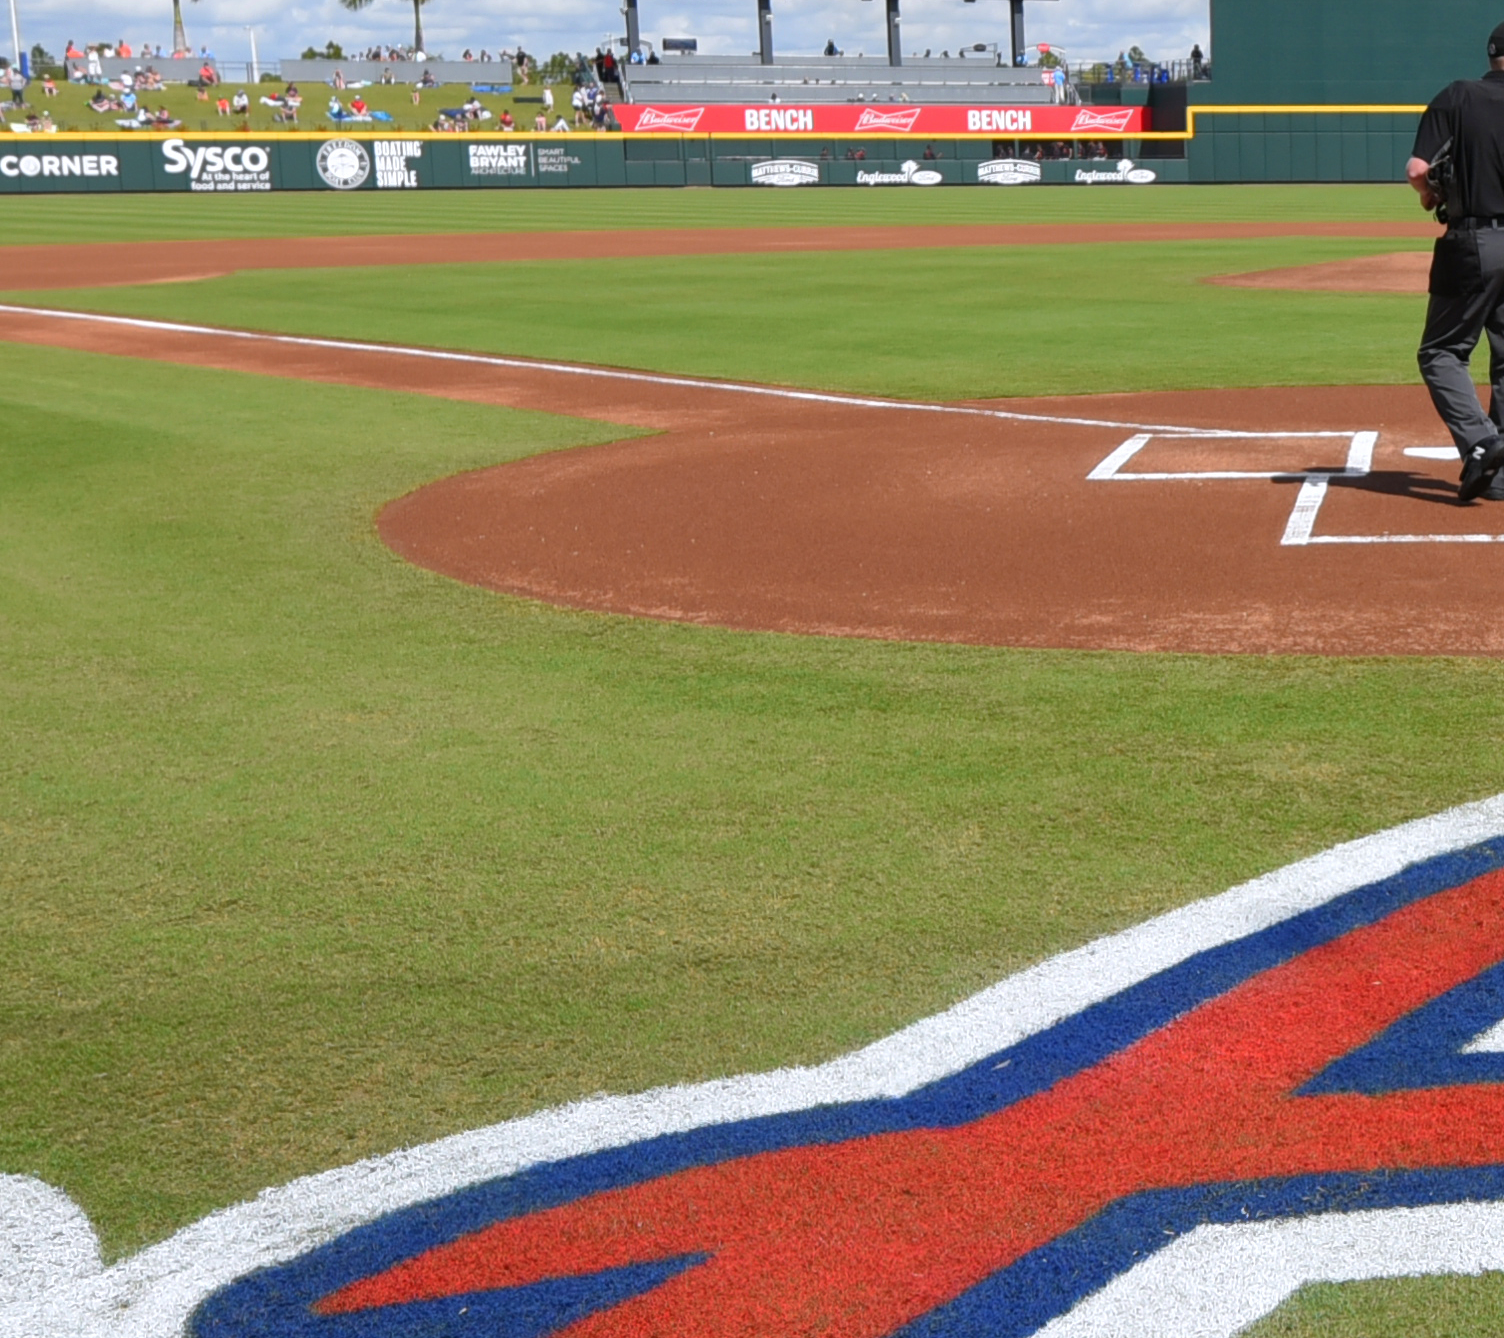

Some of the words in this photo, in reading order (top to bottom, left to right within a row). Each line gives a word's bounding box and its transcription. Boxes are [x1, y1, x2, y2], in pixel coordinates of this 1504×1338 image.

[638, 113, 699, 127] Budweiser
[745, 109, 814, 131] BENCH
[858, 113, 917, 127] Budweiser
[967, 110, 1032, 131] BENCH
[1074, 114, 1130, 128] Budweiser
[373, 140, 421, 157] BOATING
[468, 144, 526, 157] FAWLEY
[537, 148, 565, 156] SMART
[0, 155, 119, 177] CORNER
[375, 156, 406, 171] MADE
[469, 156, 527, 168] BRYANT
[538, 156, 581, 164] BEAUTIFUL
[538, 164, 569, 172] SPACES
[201, 171, 213, 181] At
[215, 171, 230, 181] the
[232, 171, 258, 181] heart
[259, 171, 270, 181] of
[376, 170, 418, 188] SIMPLE
[856, 170, 908, 186] Englewood
[191, 181, 215, 190] food
[216, 181, 235, 190] and
[237, 181, 271, 190] service
